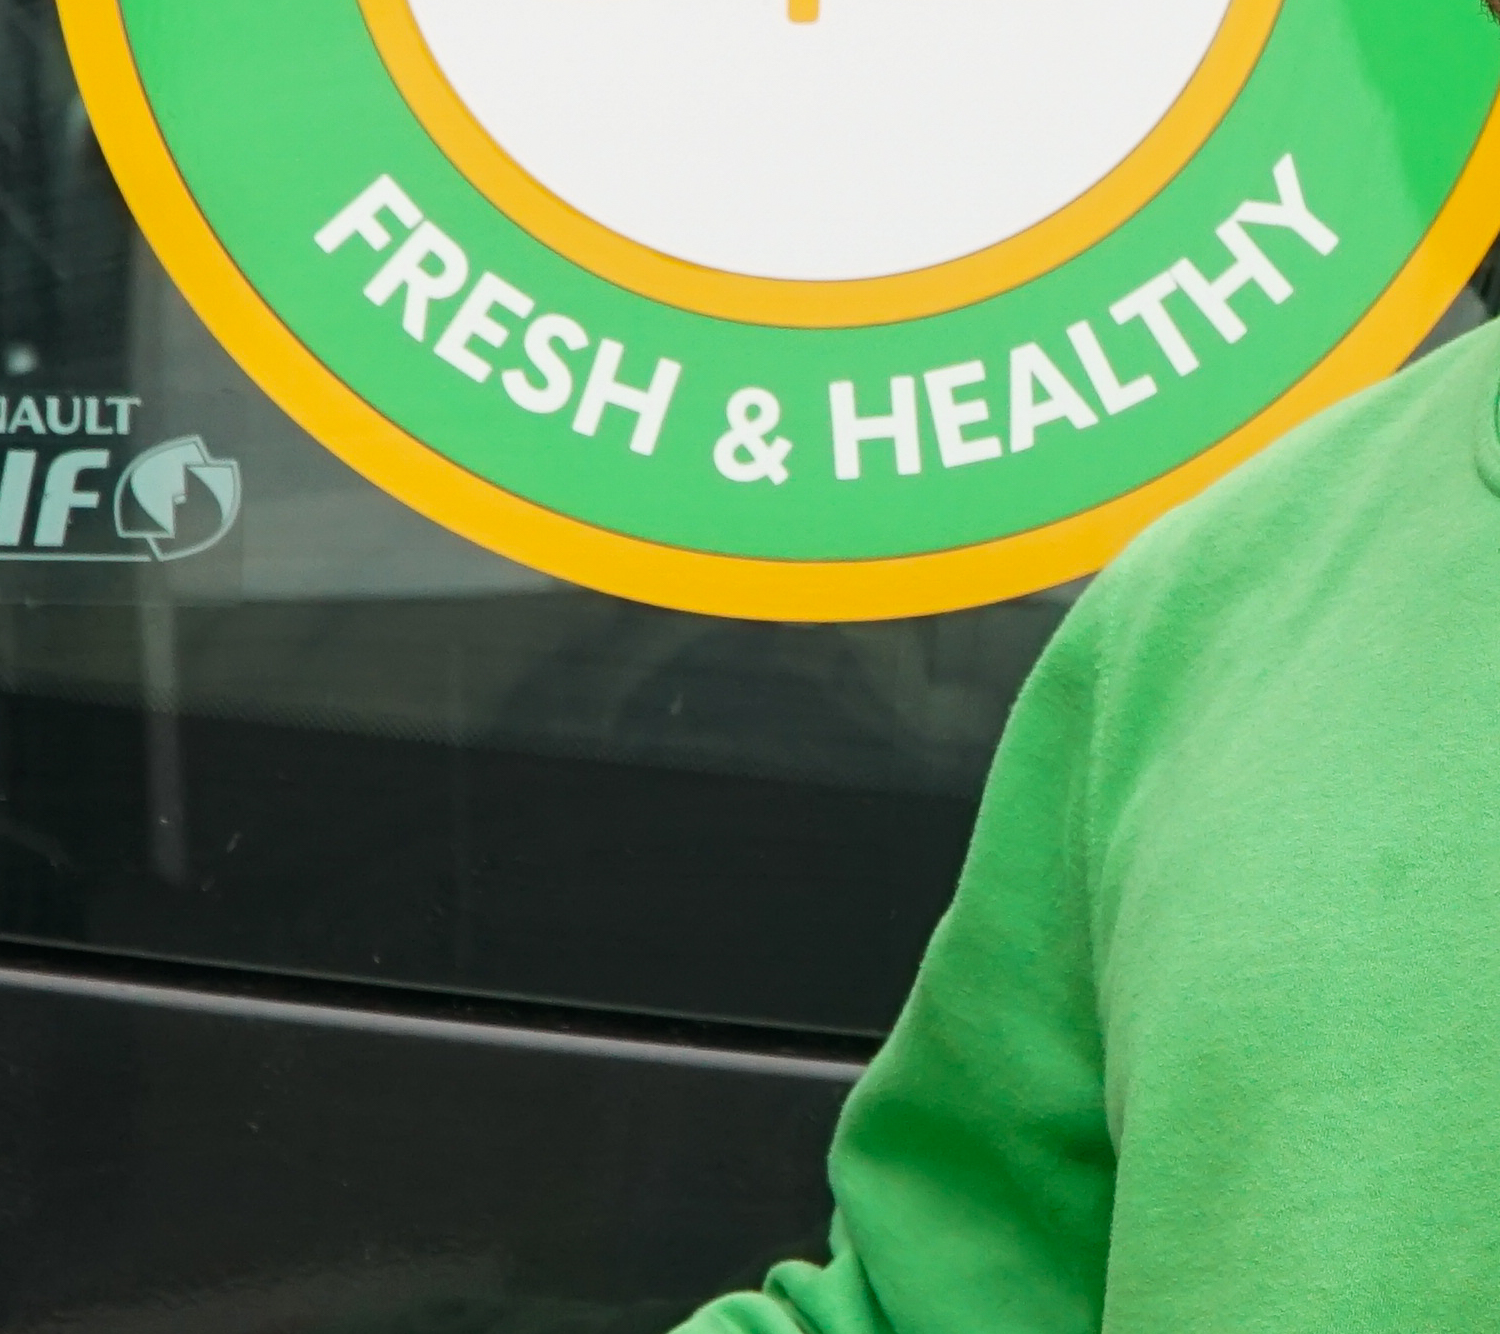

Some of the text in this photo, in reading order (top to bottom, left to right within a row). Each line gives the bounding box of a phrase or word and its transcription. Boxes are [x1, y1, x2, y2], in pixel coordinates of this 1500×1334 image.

[313, 152, 1341, 486] FRESH & HEALTHY
